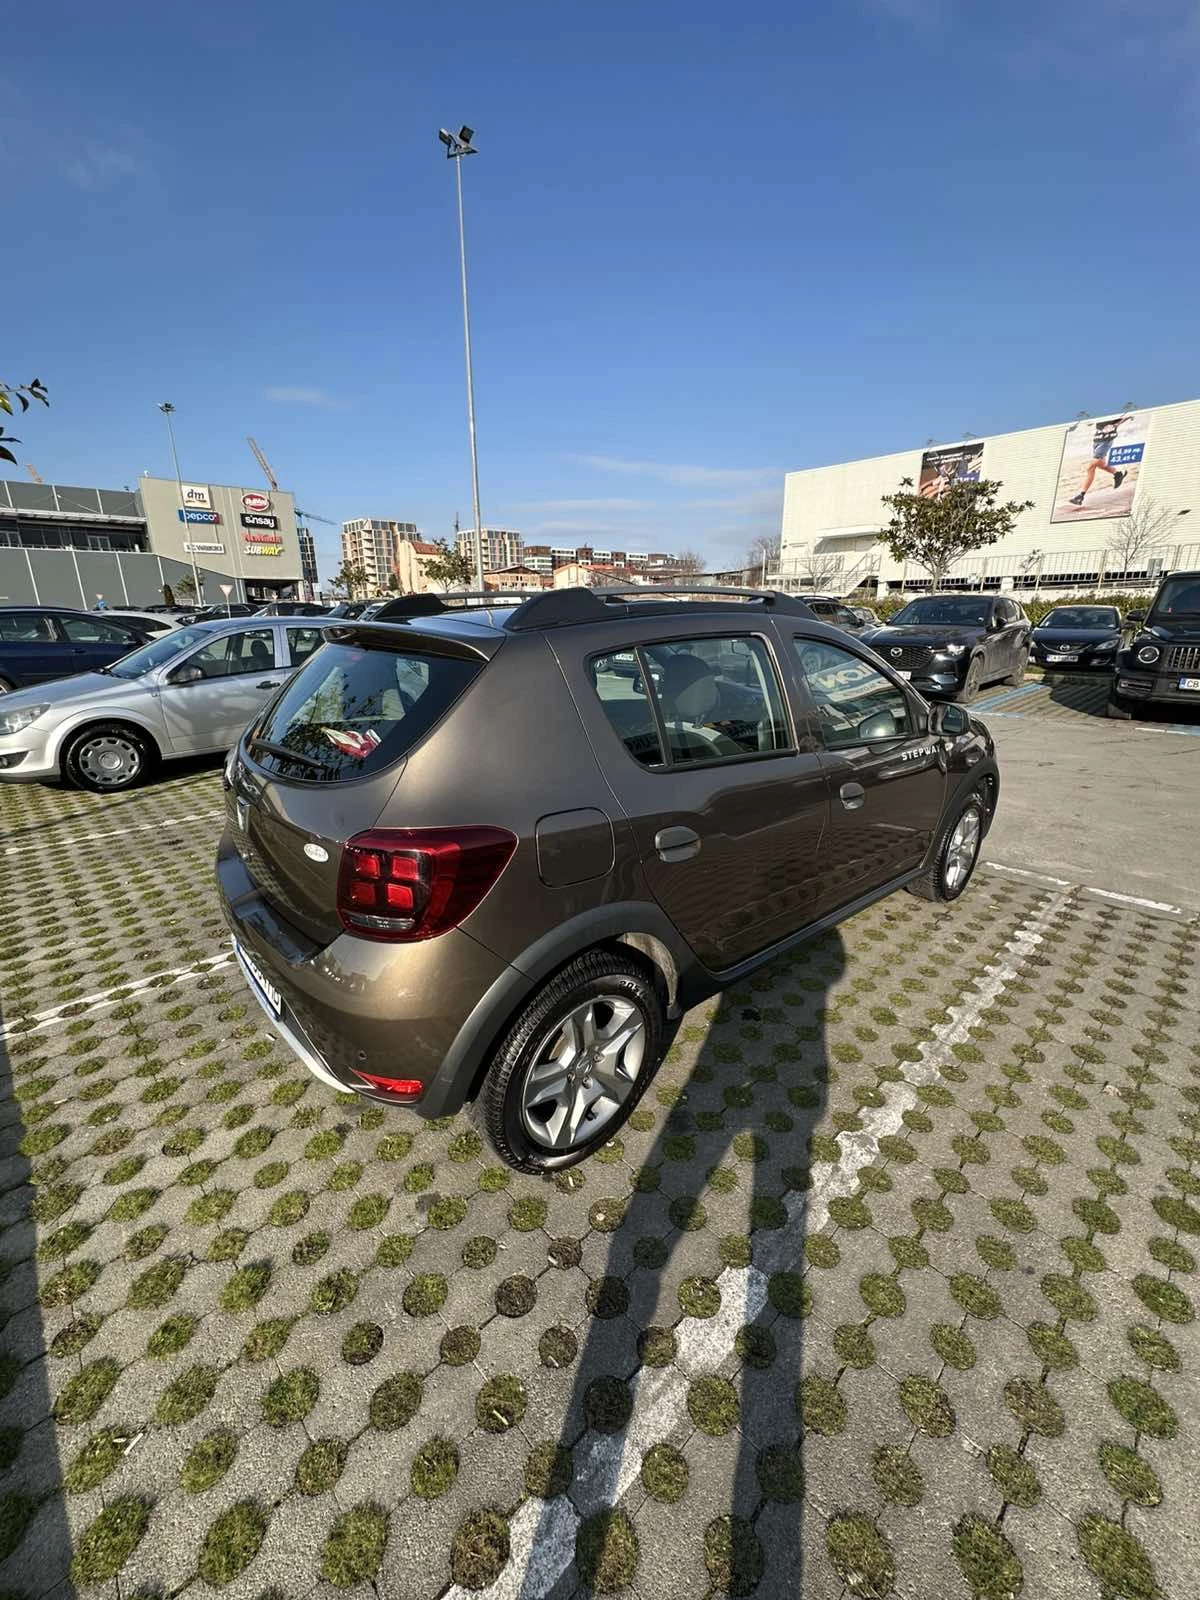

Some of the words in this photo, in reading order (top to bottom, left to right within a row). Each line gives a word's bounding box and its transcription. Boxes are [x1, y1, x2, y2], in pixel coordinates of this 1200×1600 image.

[187, 489, 204, 499] dm
[245, 514, 275, 528] sinsay
[243, 545, 282, 555] SUBWAY
[901, 743, 940, 761] STEPWAY
